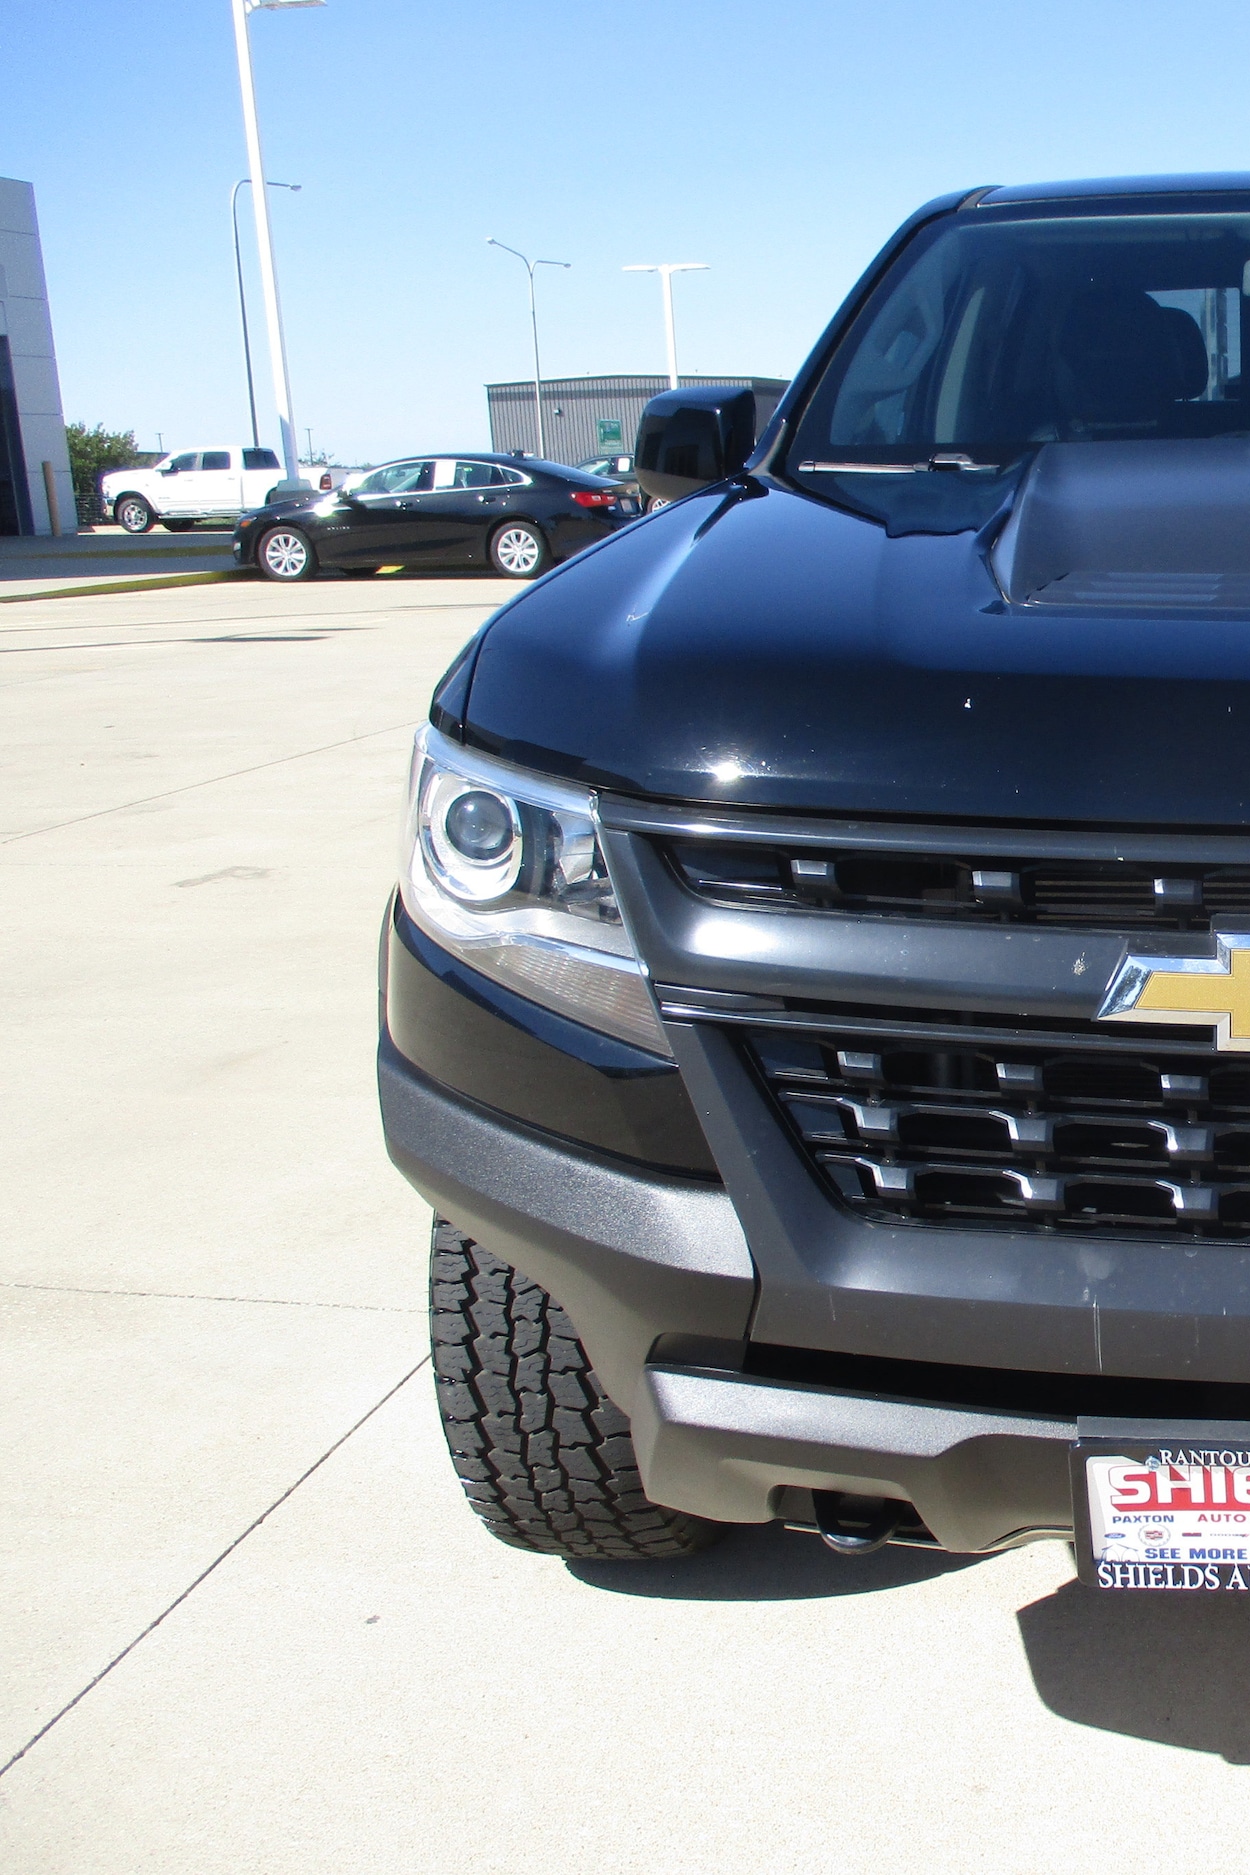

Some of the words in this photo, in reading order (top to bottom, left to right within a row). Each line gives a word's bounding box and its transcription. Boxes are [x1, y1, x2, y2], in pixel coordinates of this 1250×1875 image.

[1112, 1515, 1175, 1524] PAXTON
[1197, 1514, 1247, 1523] AUTO
[1144, 1548, 1181, 1560] SEE
[1189, 1548, 1248, 1560] MORE
[1097, 1561, 1221, 1590] SHIELDS
